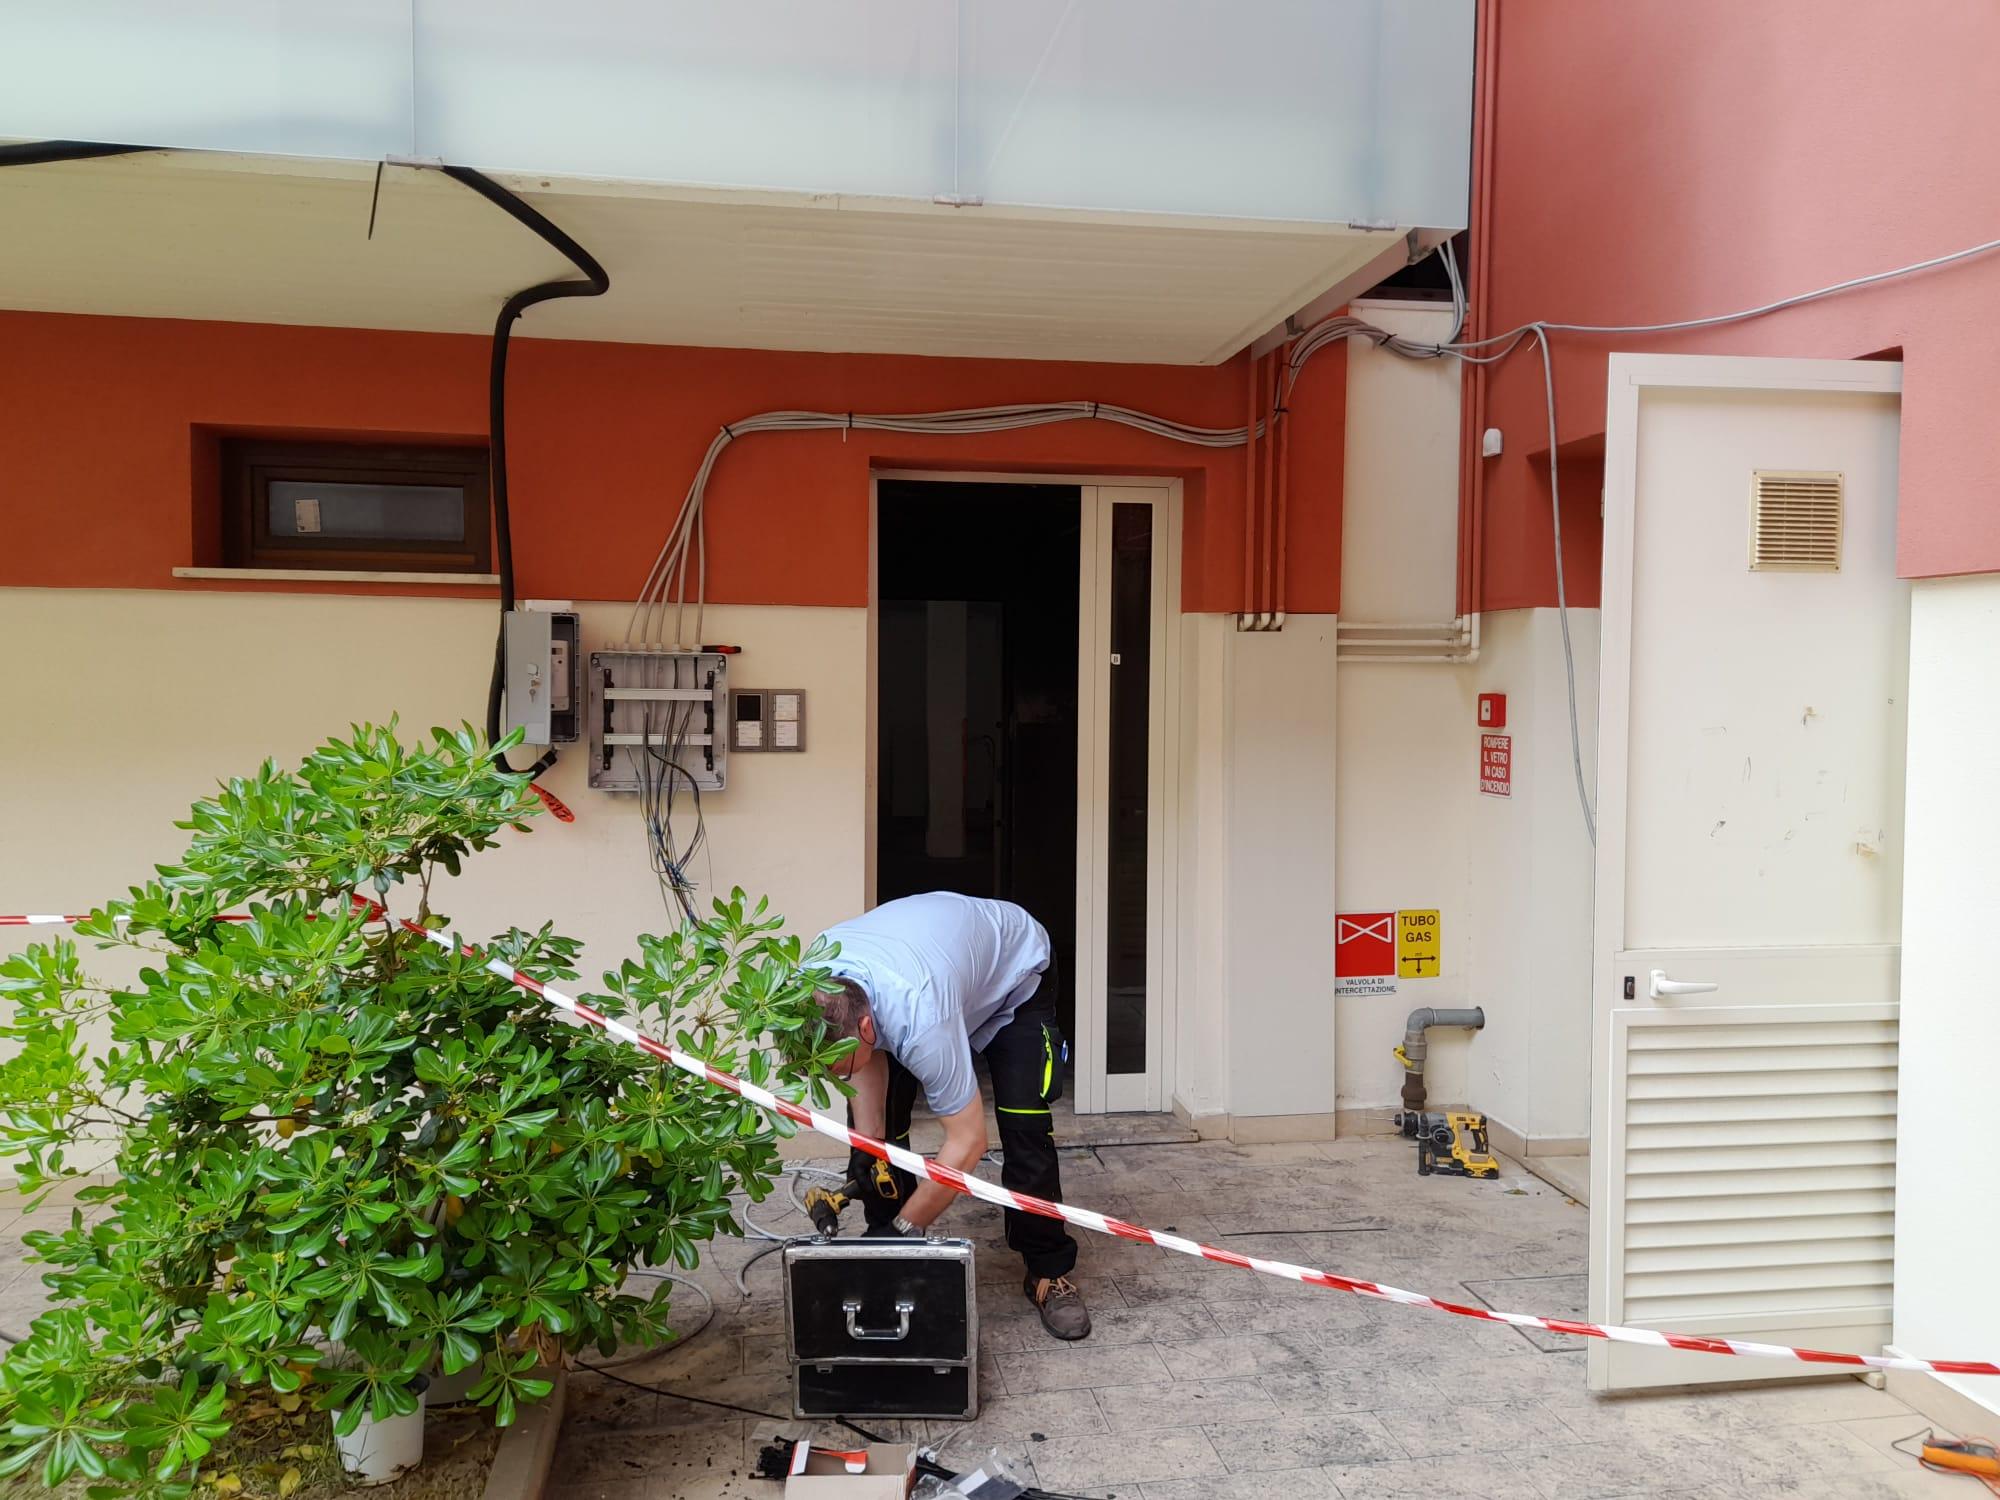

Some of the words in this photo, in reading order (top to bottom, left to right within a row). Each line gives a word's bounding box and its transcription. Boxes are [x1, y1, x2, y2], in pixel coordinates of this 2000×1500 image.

[1483, 736, 1509, 749] ROMPERE
[1490, 752, 1508, 764] VETRO
[1485, 765, 1490, 776] IN
[1491, 766, 1506, 778] CASO
[1401, 915, 1436, 926] TUBO
[1405, 932, 1432, 943] GAS
[1345, 978, 1376, 986] VALVOLA
